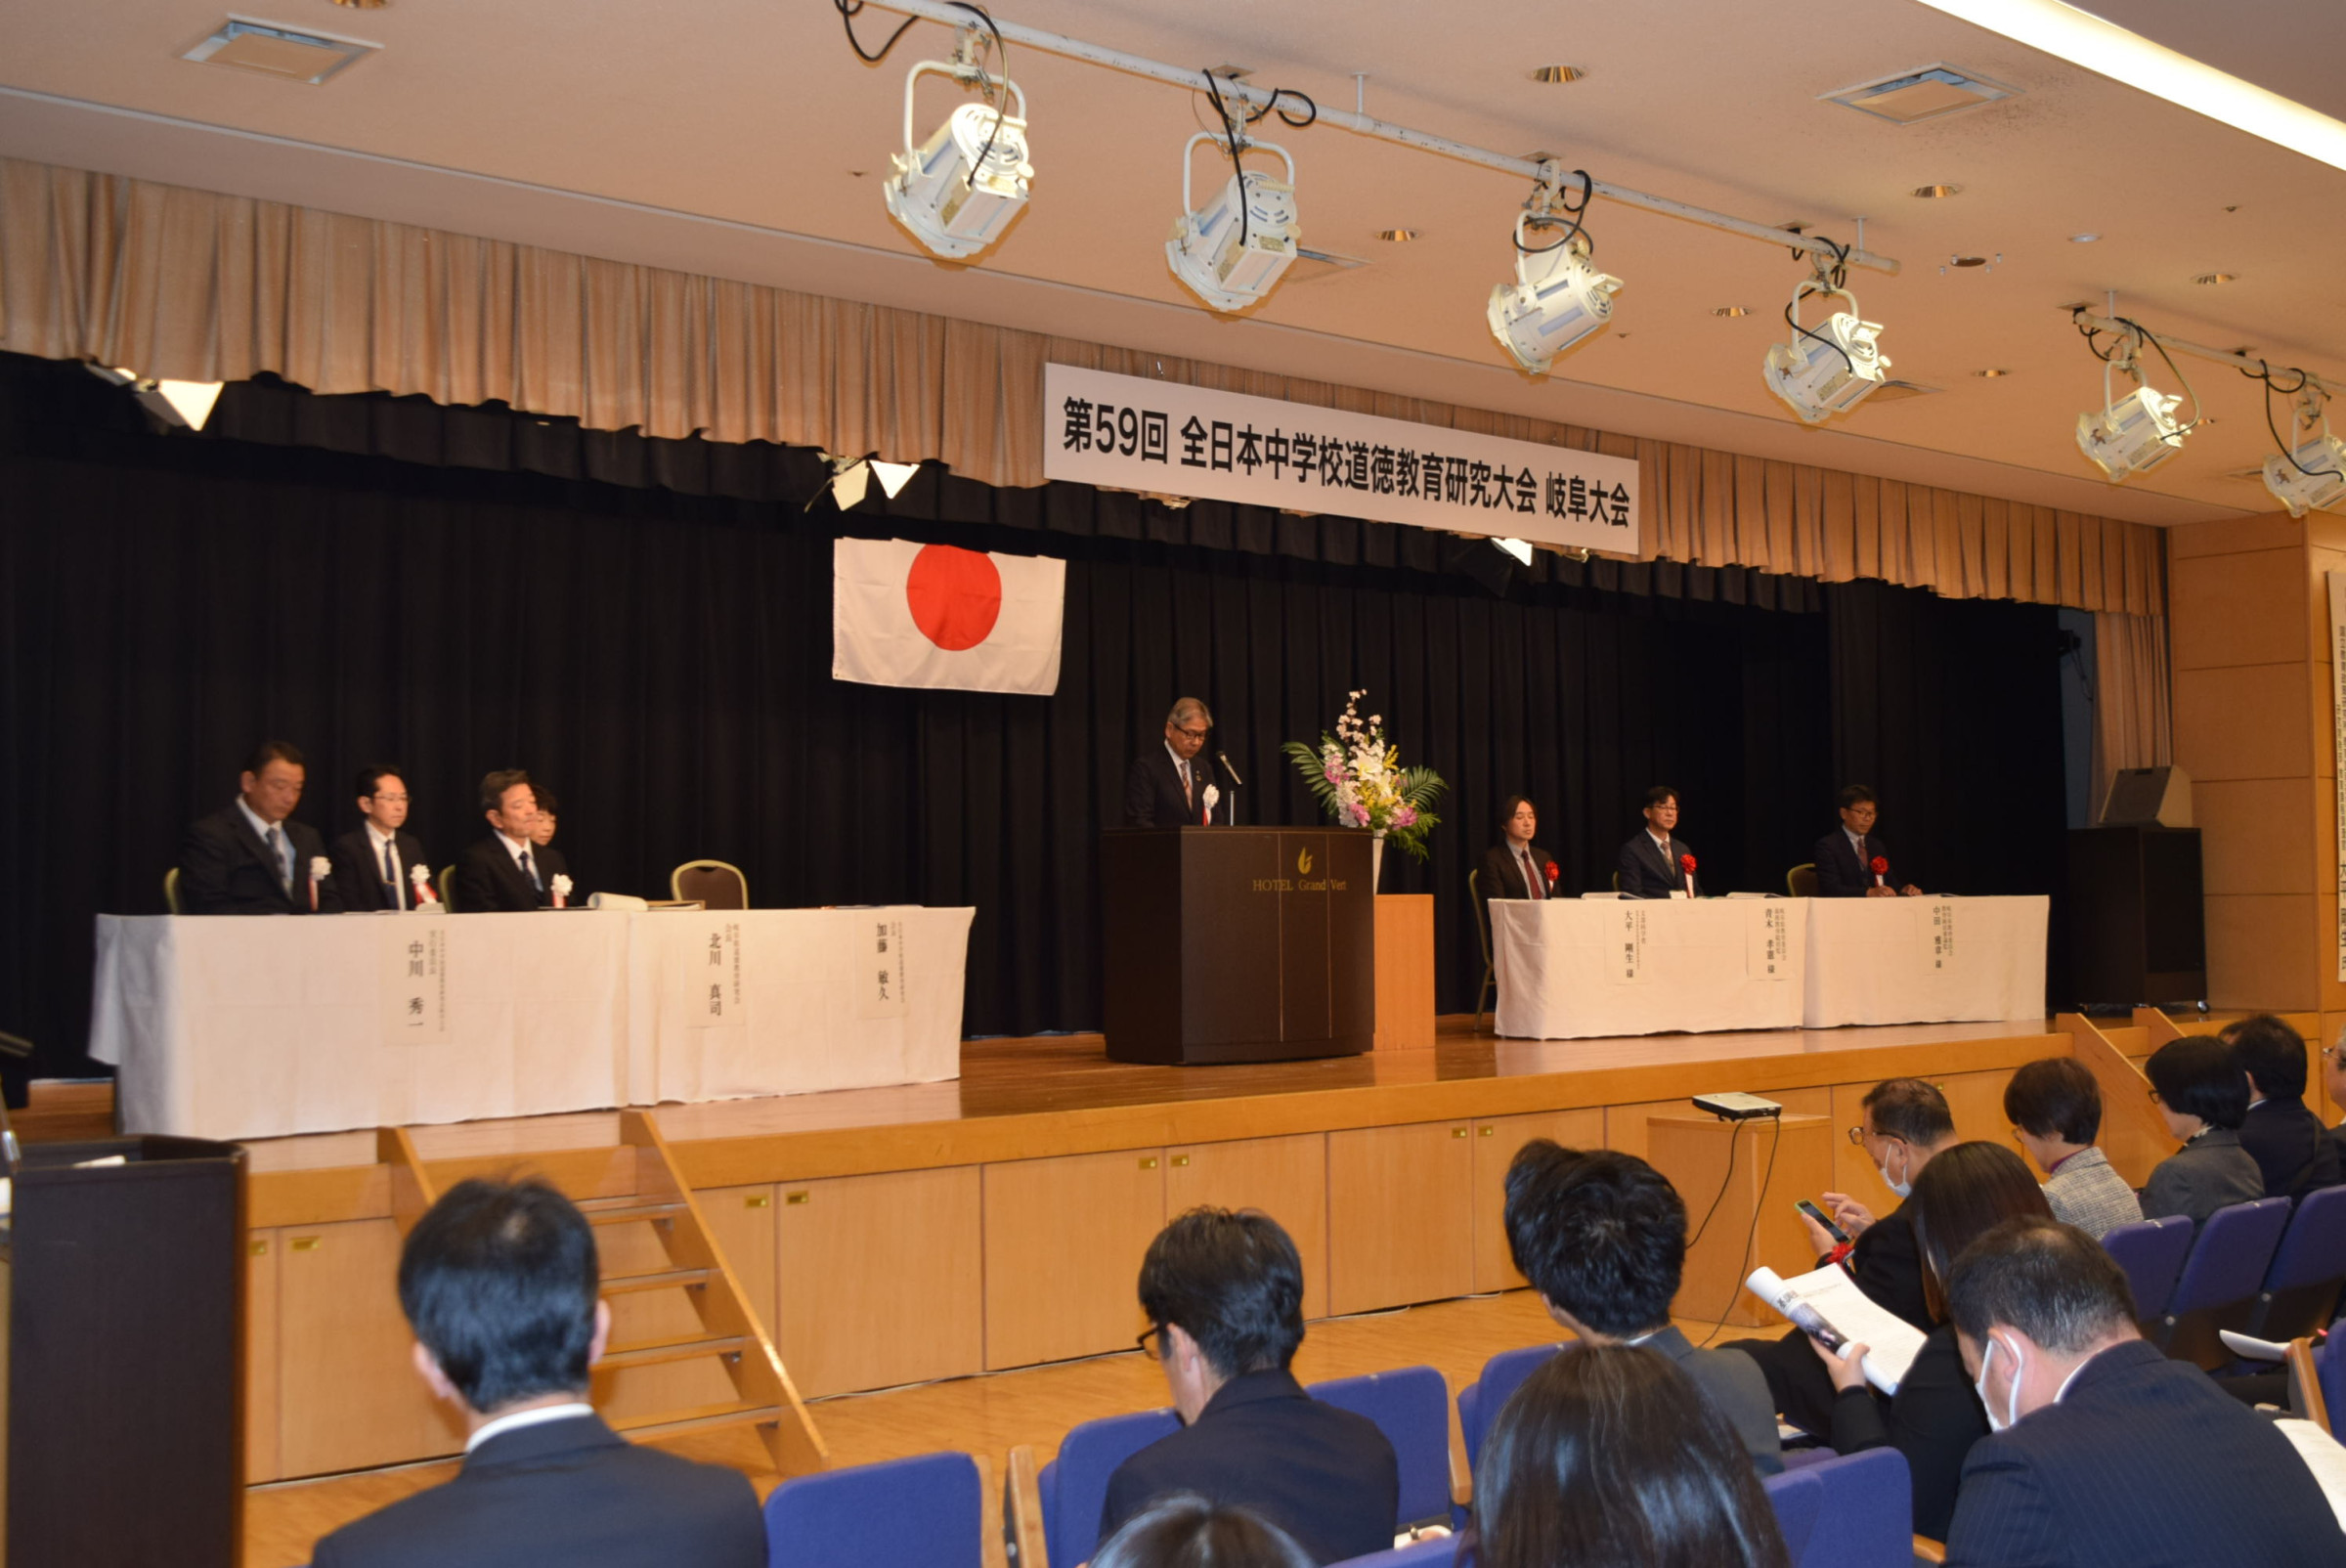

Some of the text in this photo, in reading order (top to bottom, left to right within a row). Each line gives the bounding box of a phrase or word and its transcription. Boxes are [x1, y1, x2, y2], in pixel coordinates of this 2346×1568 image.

[1064, 396, 1630, 529] 第59回 全日本中学校道徳教育研究大会 岐阜大会
[1252, 879, 1346, 892] HOTEL Grand Vert
[408, 939, 424, 1026] 中川 秀一
[709, 933, 721, 1017] 北川 真司
